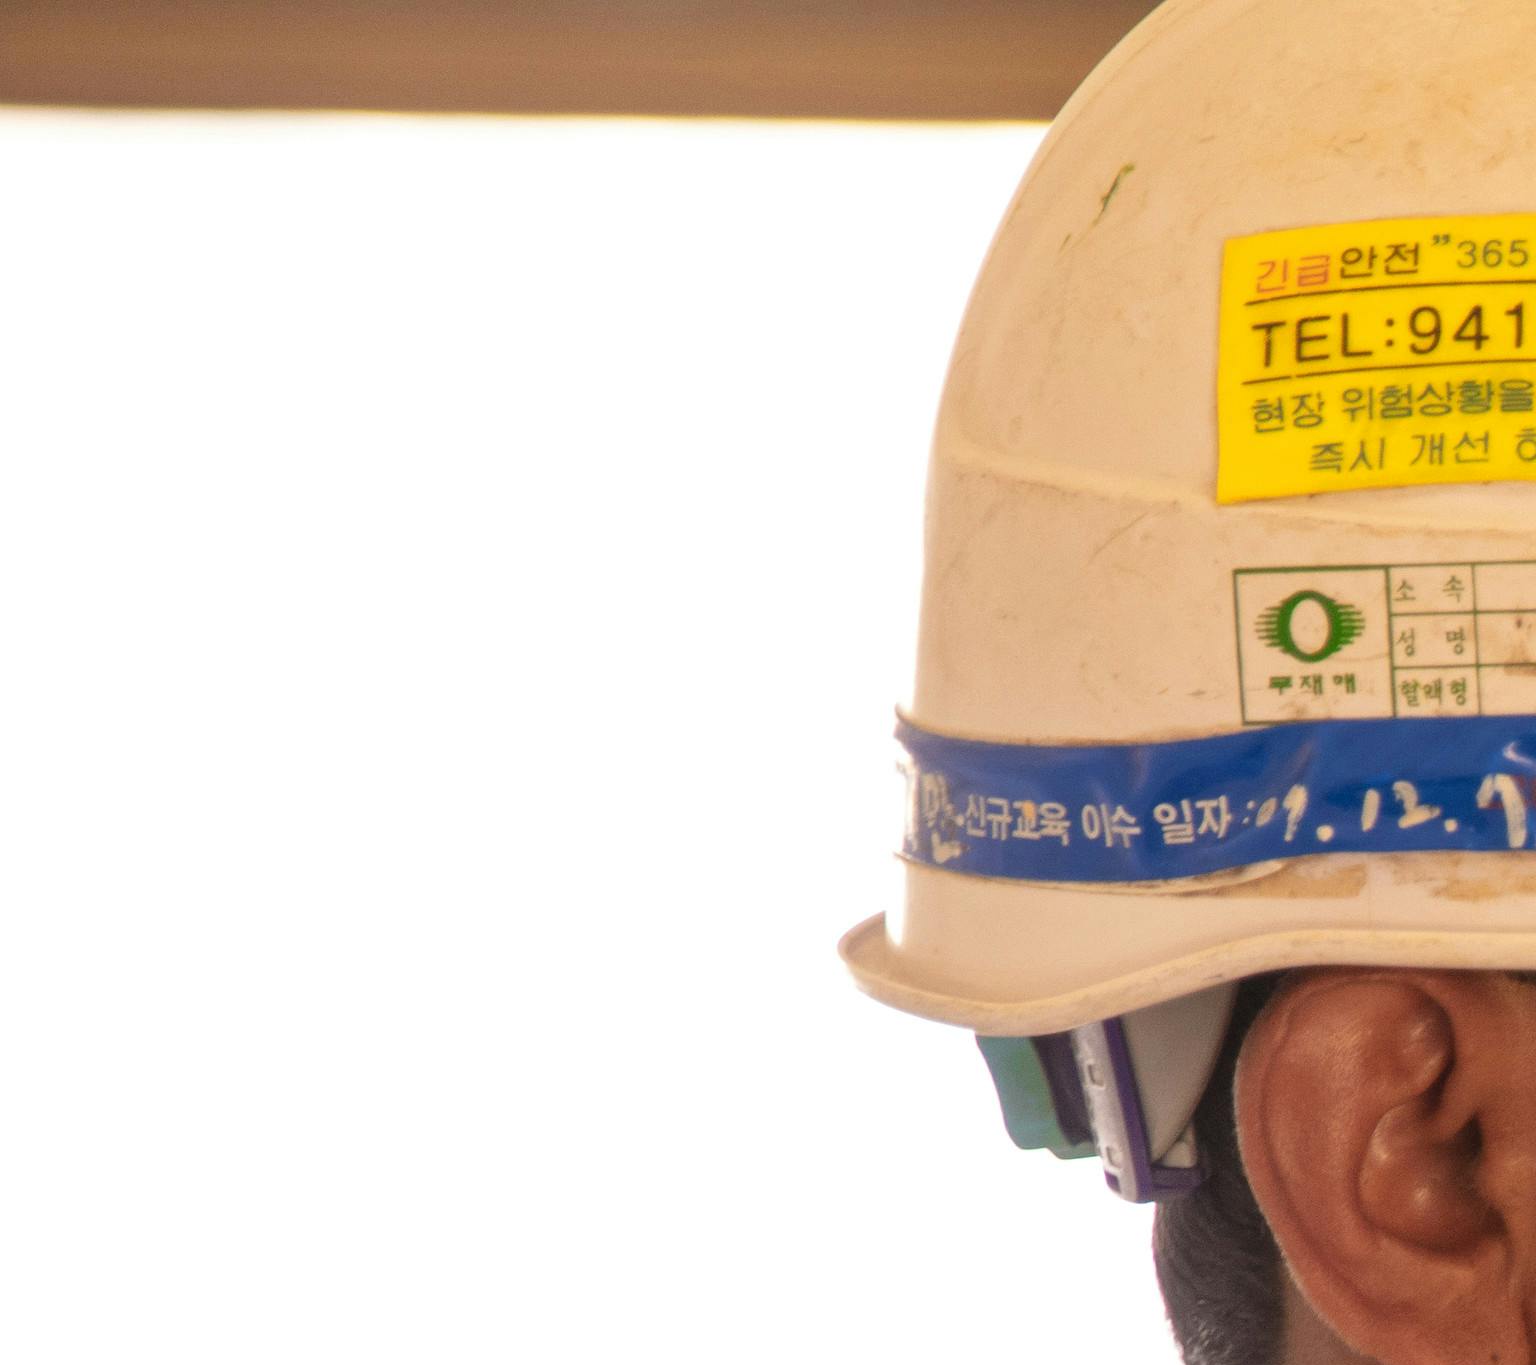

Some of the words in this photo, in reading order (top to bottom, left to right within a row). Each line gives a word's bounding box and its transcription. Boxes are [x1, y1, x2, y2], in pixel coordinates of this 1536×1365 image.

[1255, 243, 1420, 294] 긴급안전
[1251, 391, 1325, 434] 현장
[1341, 379, 1536, 423] 위험상황을
[1309, 436, 1387, 473] 즉시
[1410, 430, 1491, 467] 개선
[1081, 803, 1142, 849] 이수
